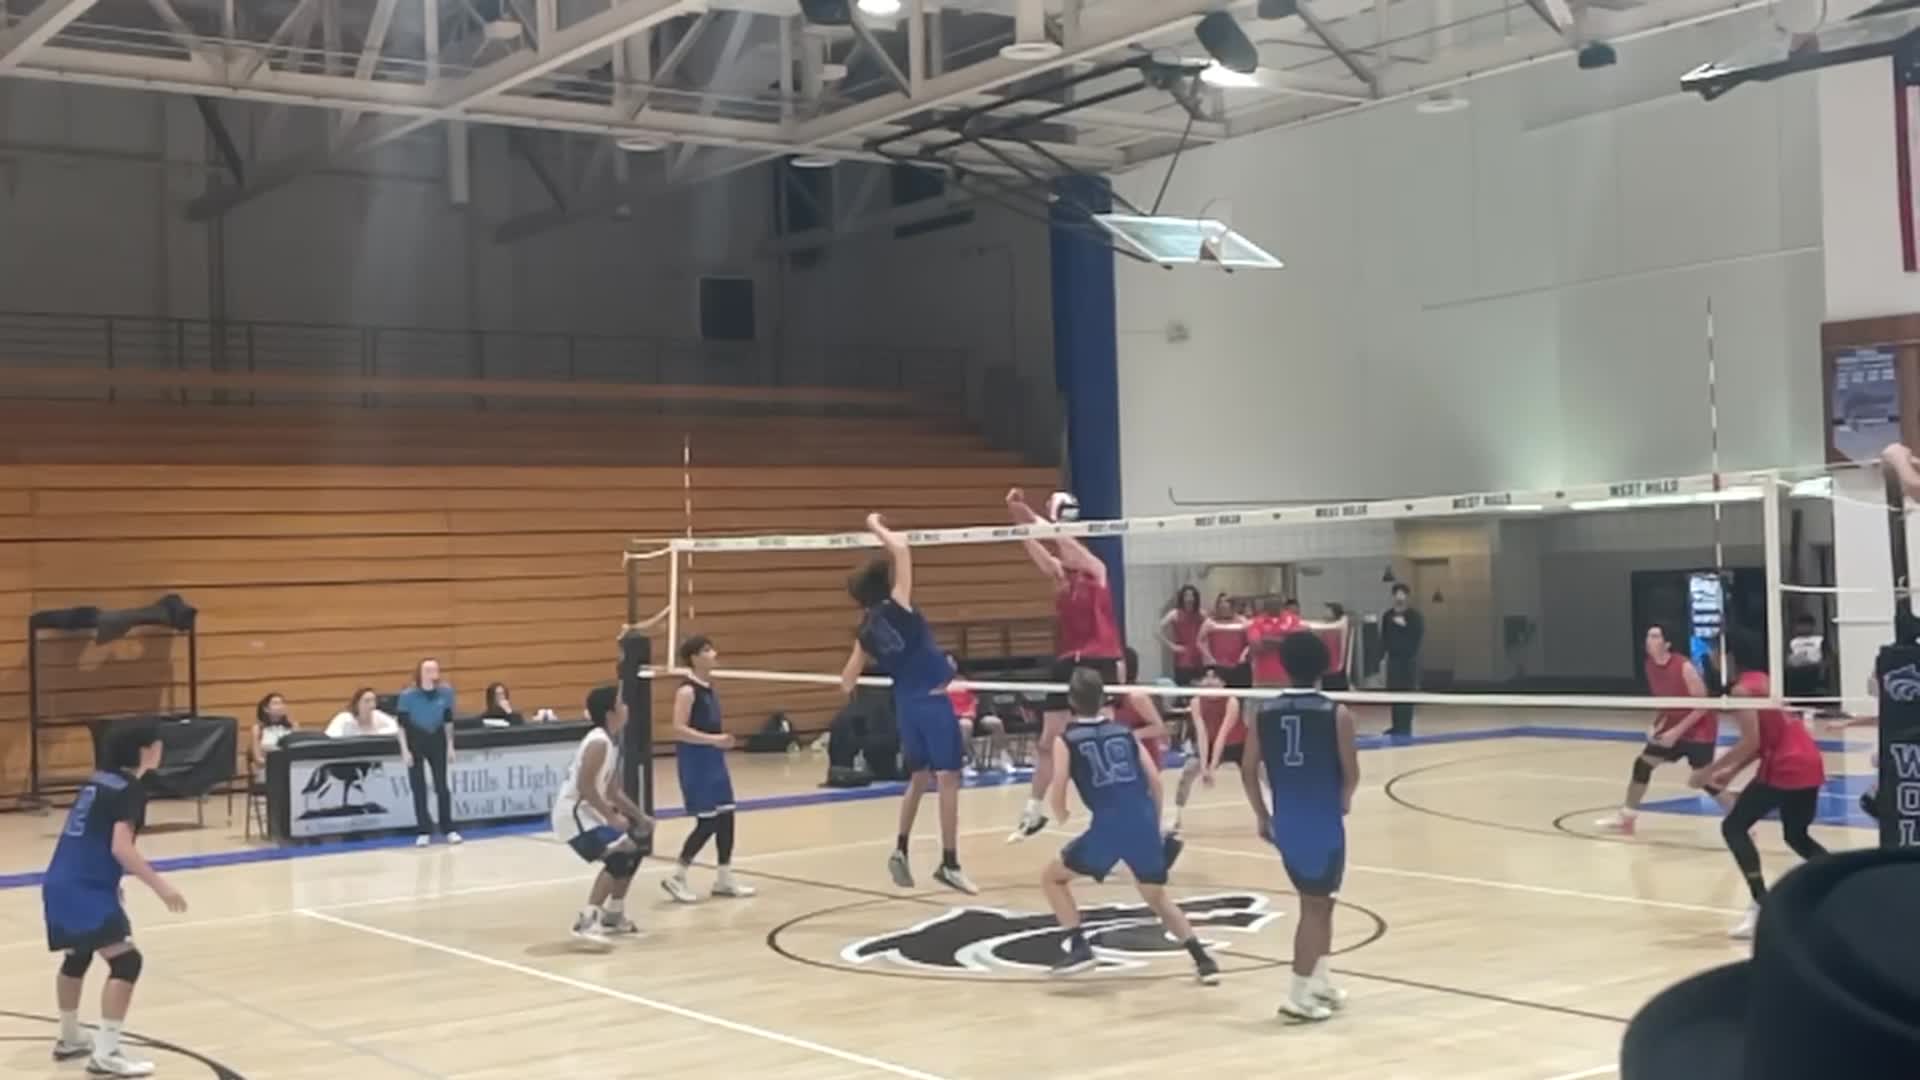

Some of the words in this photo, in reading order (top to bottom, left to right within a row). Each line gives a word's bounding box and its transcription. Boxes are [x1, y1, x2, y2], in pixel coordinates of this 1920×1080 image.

[1453, 495, 1480, 509] WEST
[1609, 483, 1642, 498] WEST
[1645, 480, 1679, 495] HILLS
[1280, 715, 1304, 767] 1
[1078, 736, 1137, 788] 19
[452, 768, 499, 794] Hills
[507, 763, 559, 792] High
